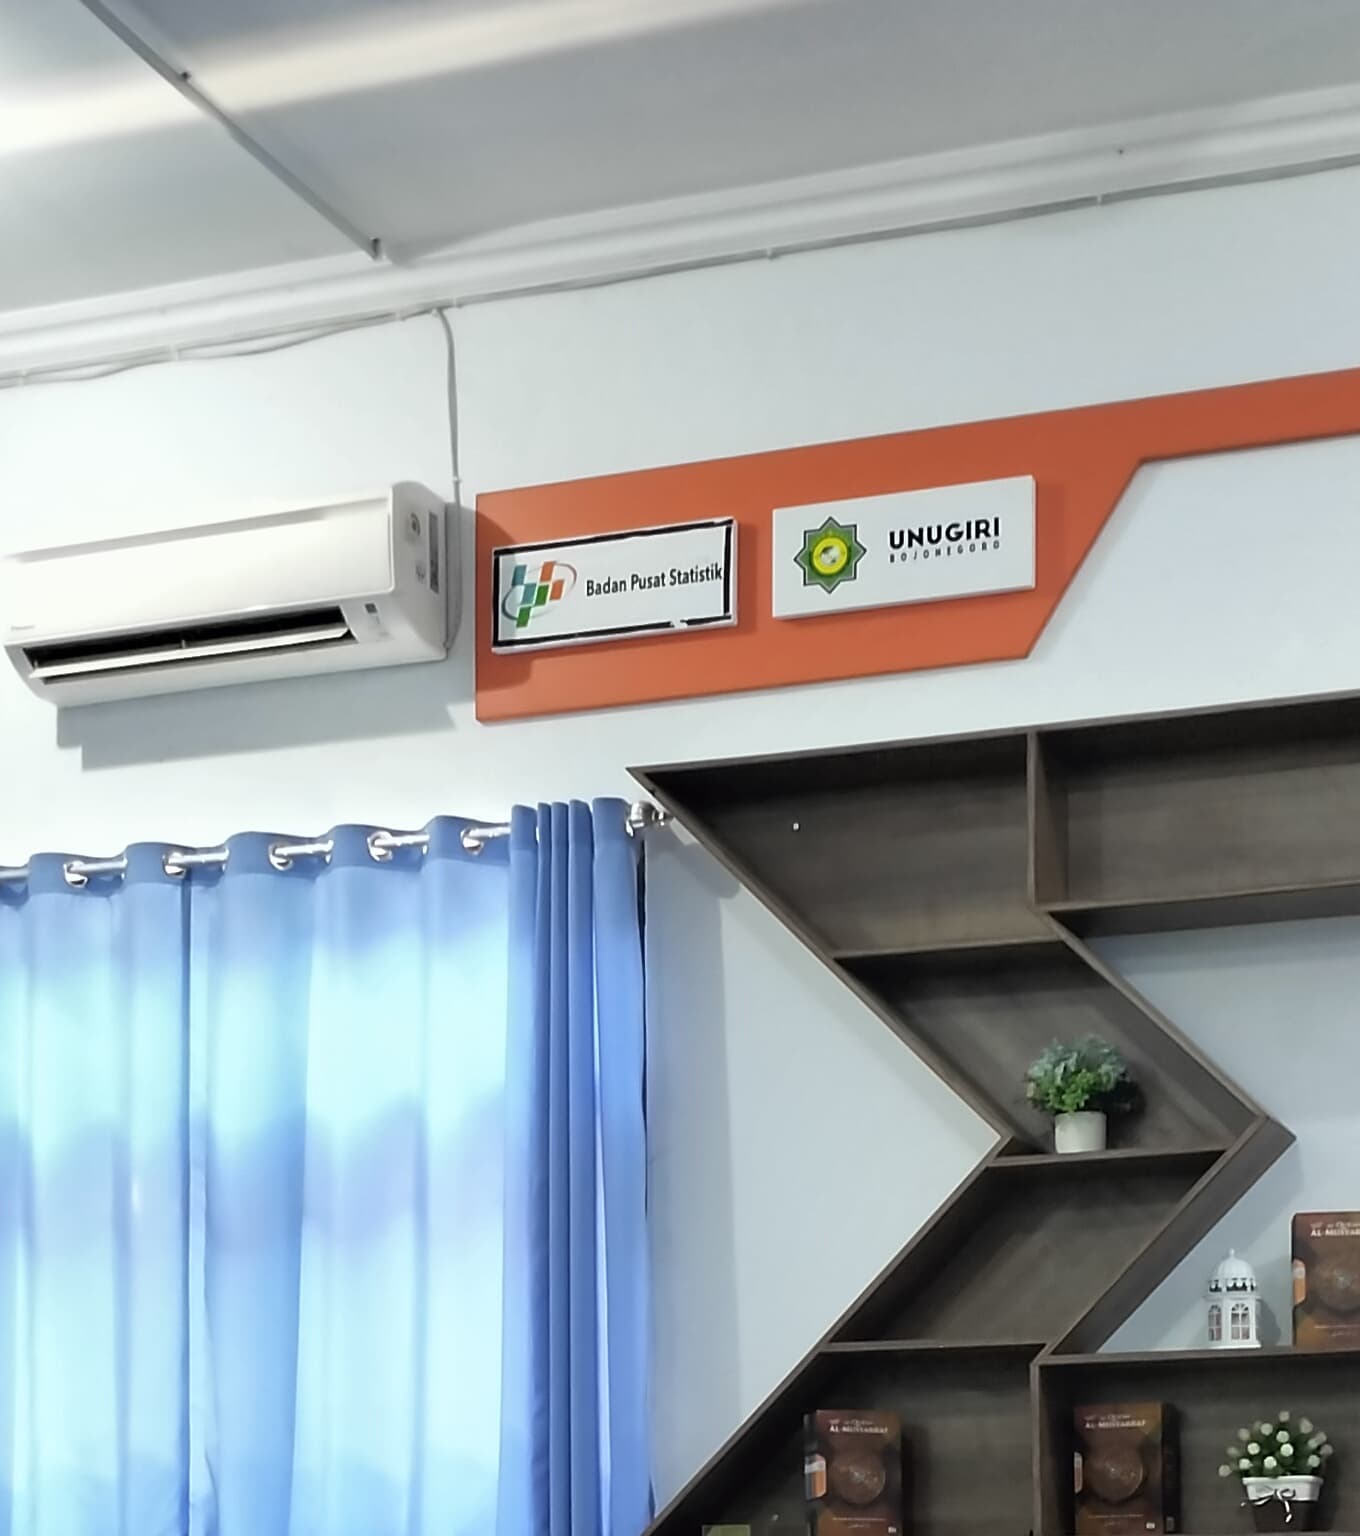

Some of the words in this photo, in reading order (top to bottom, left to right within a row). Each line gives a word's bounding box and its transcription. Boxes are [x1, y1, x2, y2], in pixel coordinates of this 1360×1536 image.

[889, 517, 1000, 550] UNUGIRI
[586, 578, 627, 597] Badan
[630, 571, 667, 591] Pusat
[669, 562, 724, 587] Statistik
